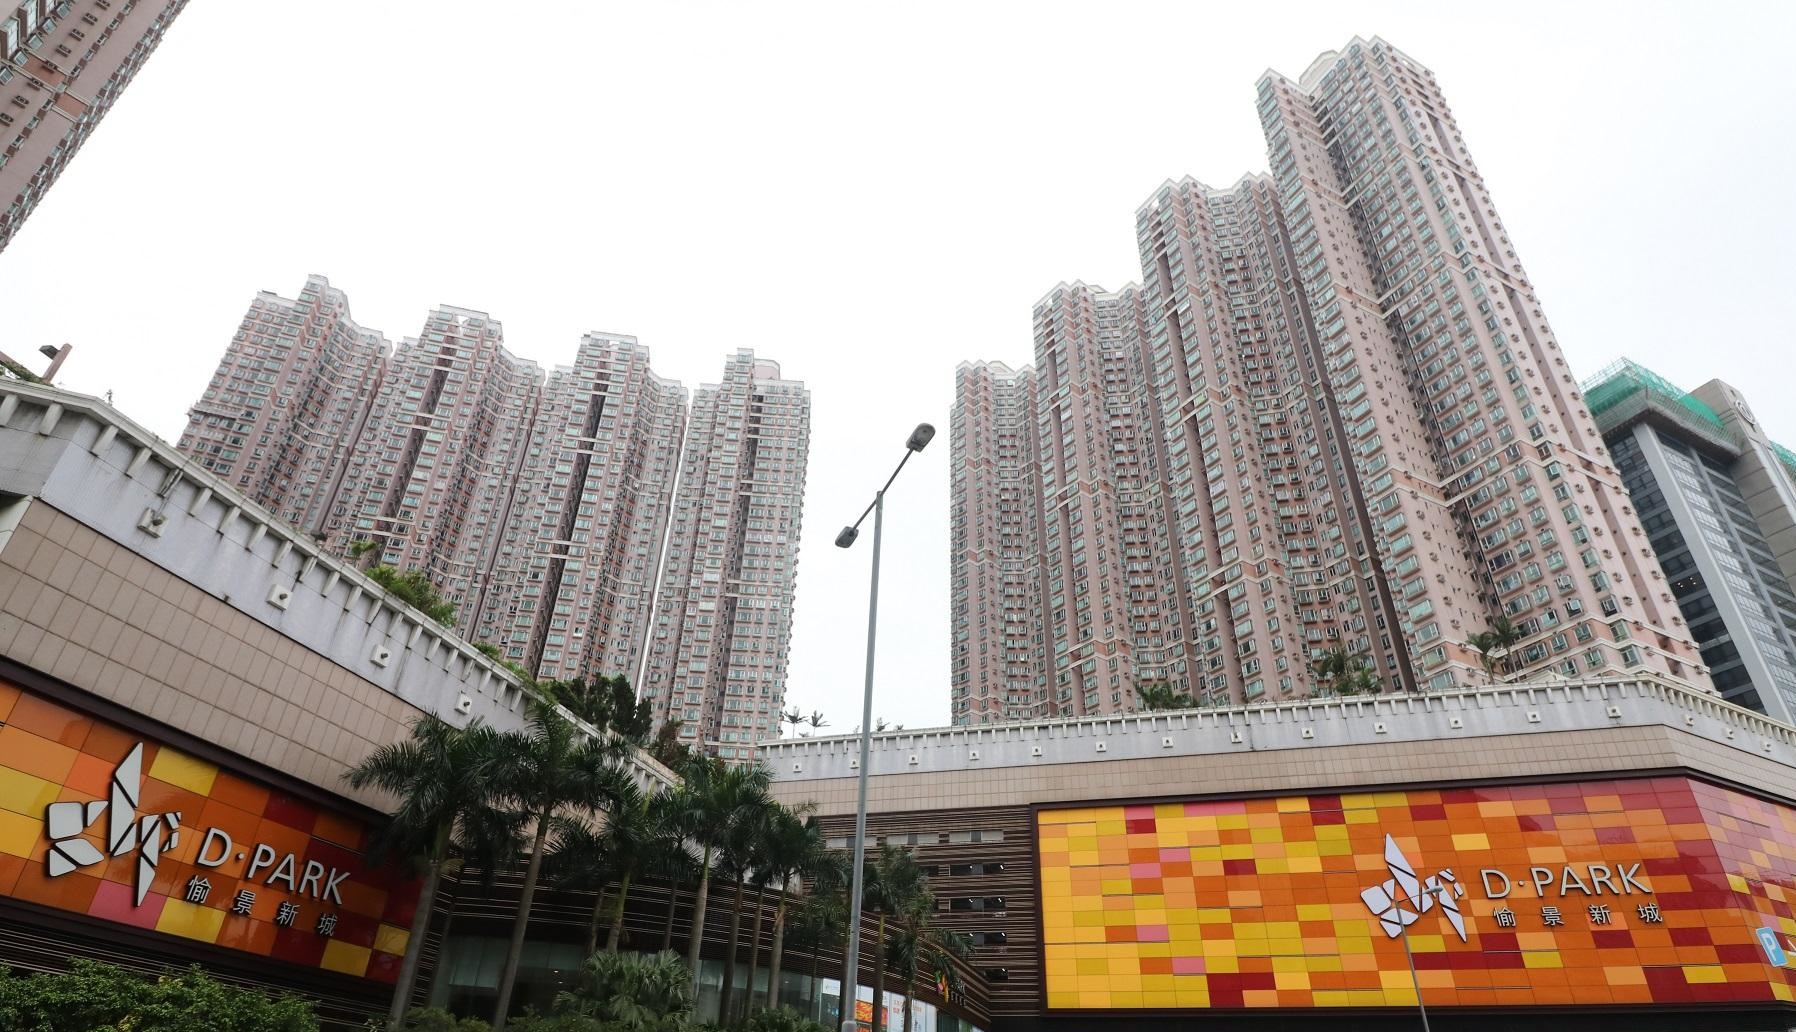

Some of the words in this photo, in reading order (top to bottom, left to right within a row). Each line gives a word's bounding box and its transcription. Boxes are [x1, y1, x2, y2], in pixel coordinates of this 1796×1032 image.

[186, 875, 338, 937] 愉景新城
[1493, 902, 1663, 927] 愉景新城
[1761, 933, 1777, 962] P
